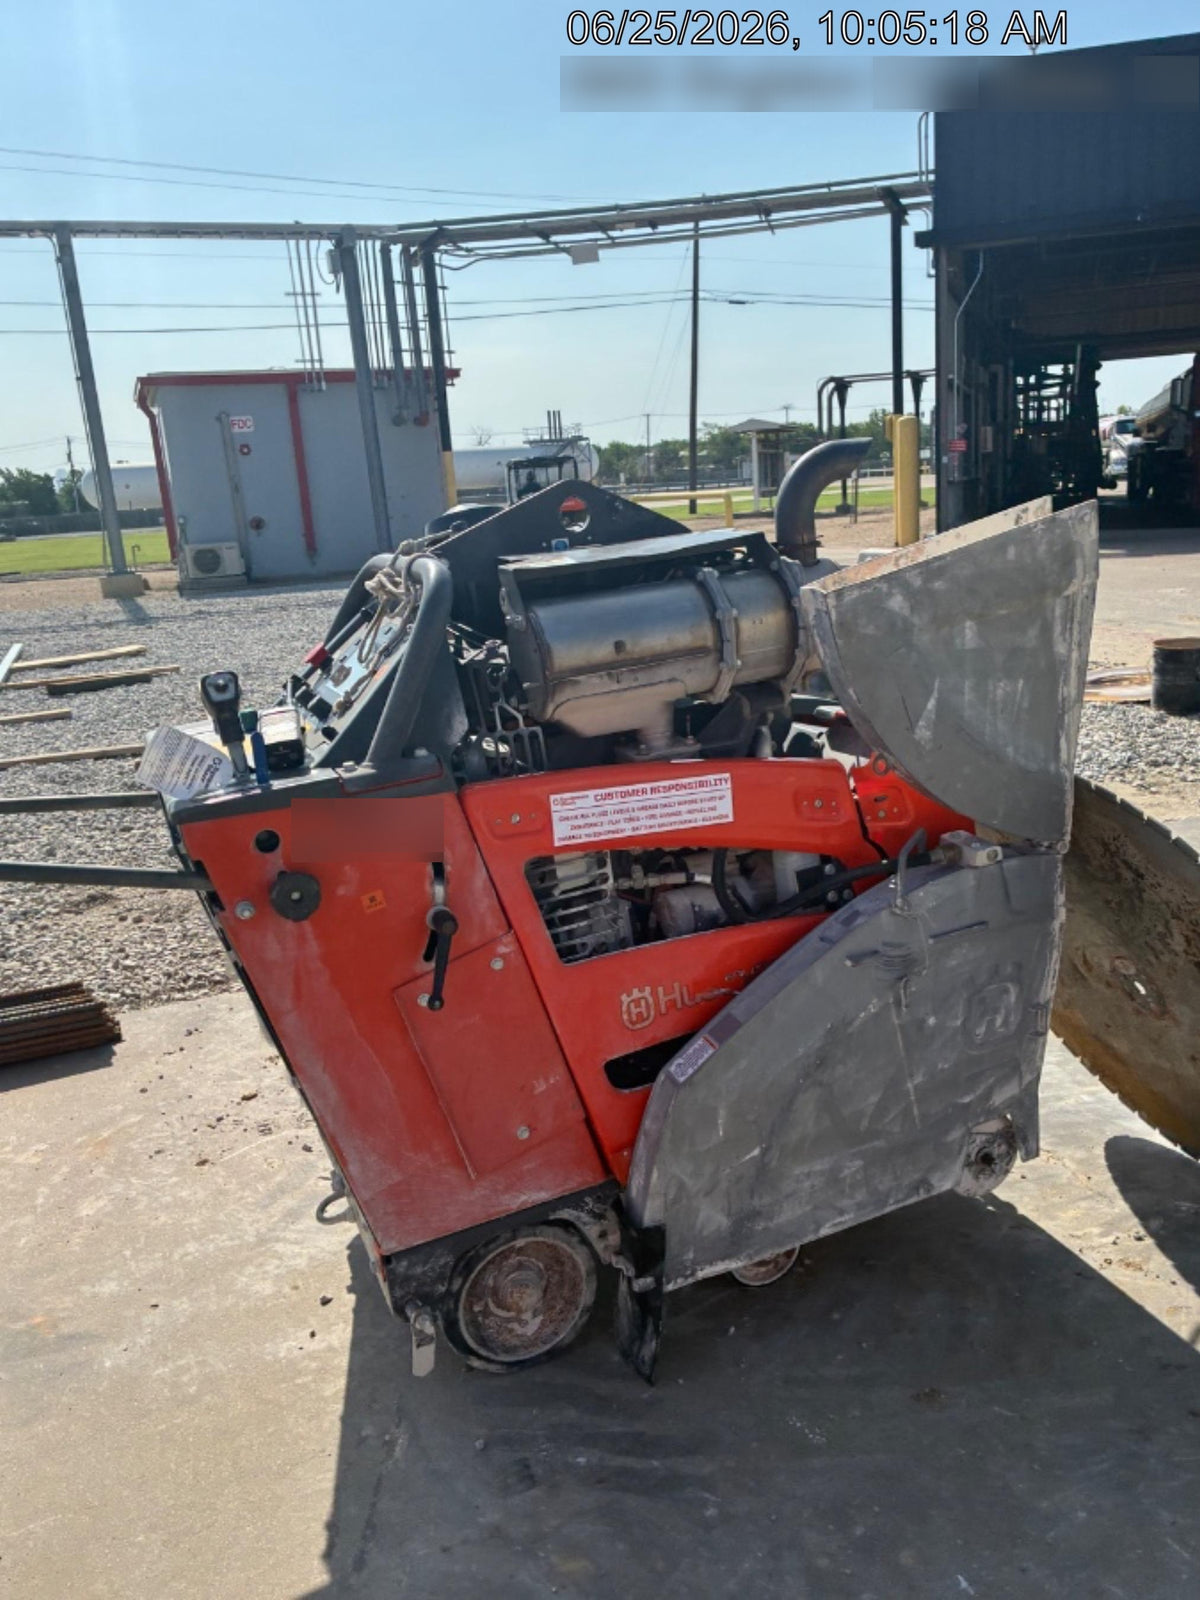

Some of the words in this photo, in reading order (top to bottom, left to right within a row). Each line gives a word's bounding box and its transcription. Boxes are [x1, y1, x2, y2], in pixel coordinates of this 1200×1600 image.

[230, 418, 252, 430] FDC
[594, 787, 648, 802] CUSTOMER
[650, 777, 730, 796] RESPONSIBILITY
